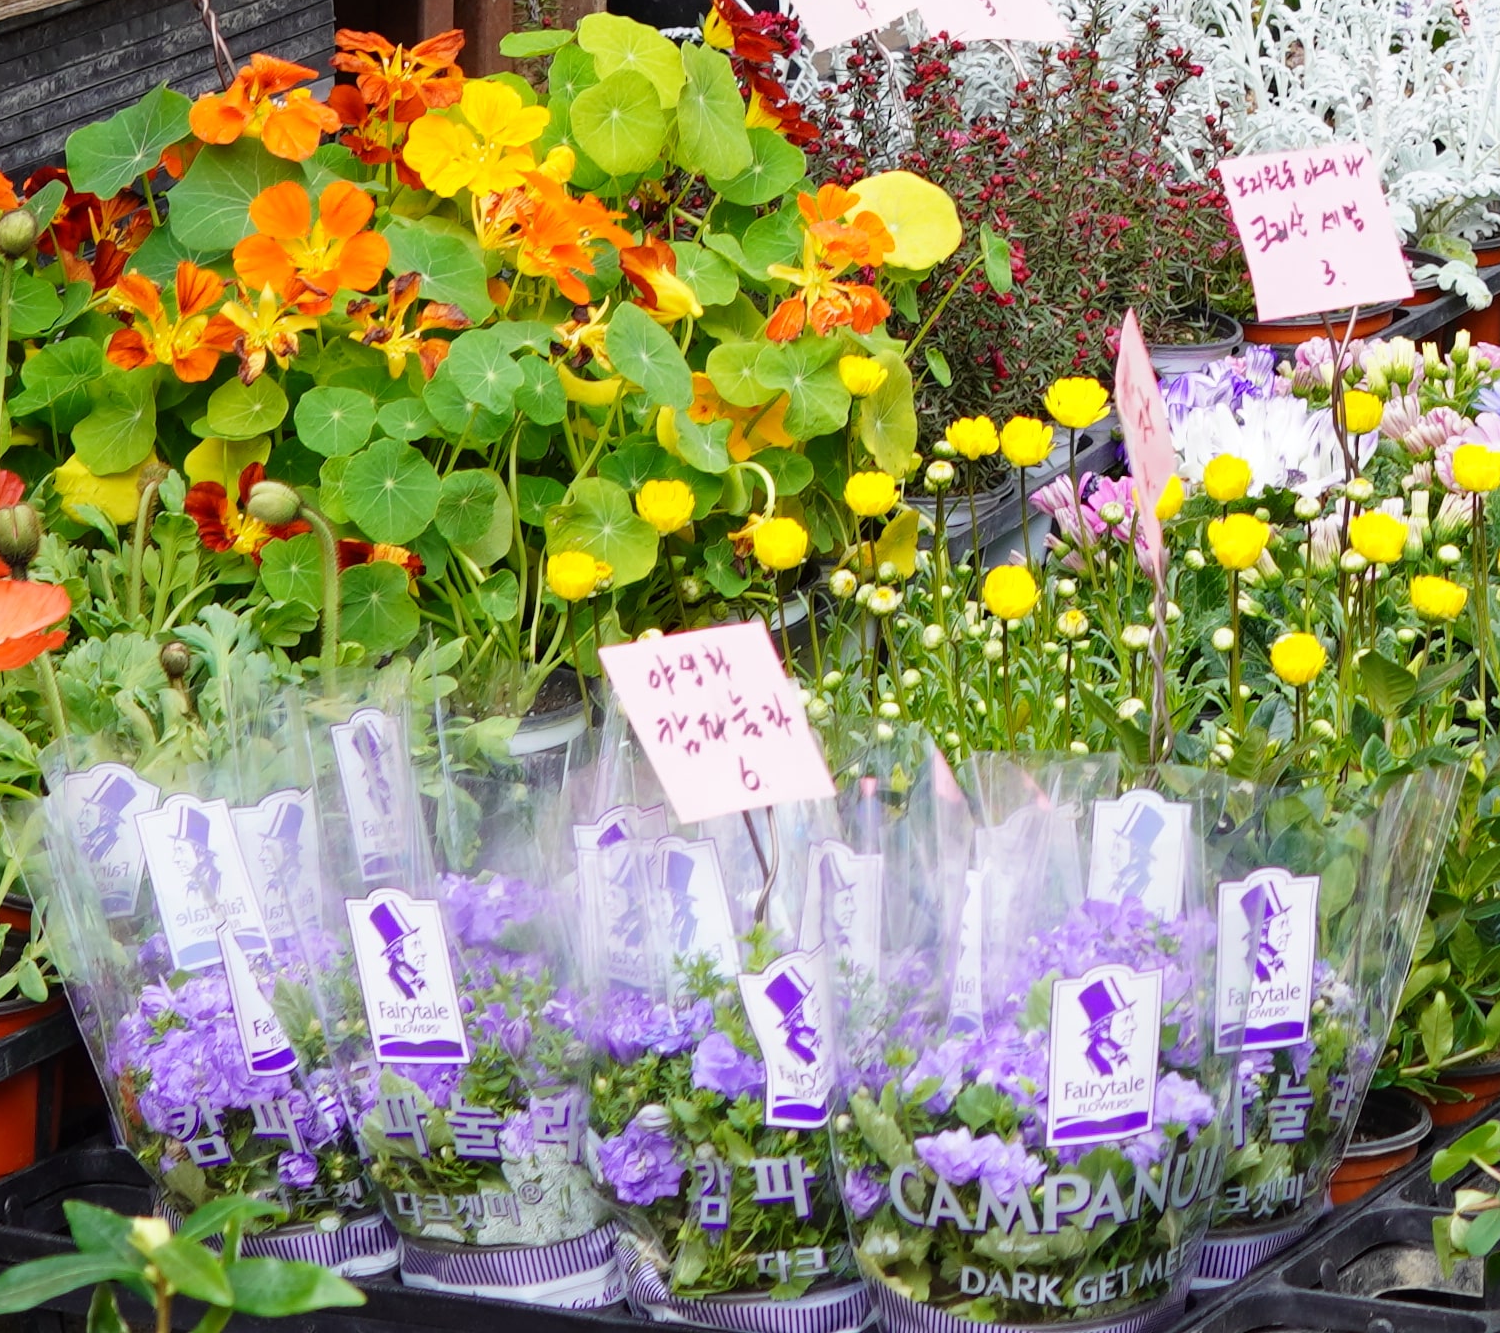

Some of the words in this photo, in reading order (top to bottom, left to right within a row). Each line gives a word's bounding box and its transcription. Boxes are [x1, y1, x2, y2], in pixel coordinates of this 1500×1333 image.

[1227, 982, 1301, 1007] Fairytale
[378, 999, 450, 1024] Fairytale
[1063, 1075, 1145, 1100] Fairytale
[959, 1265, 1064, 1307] DARK
[1073, 1262, 1132, 1306] GET
